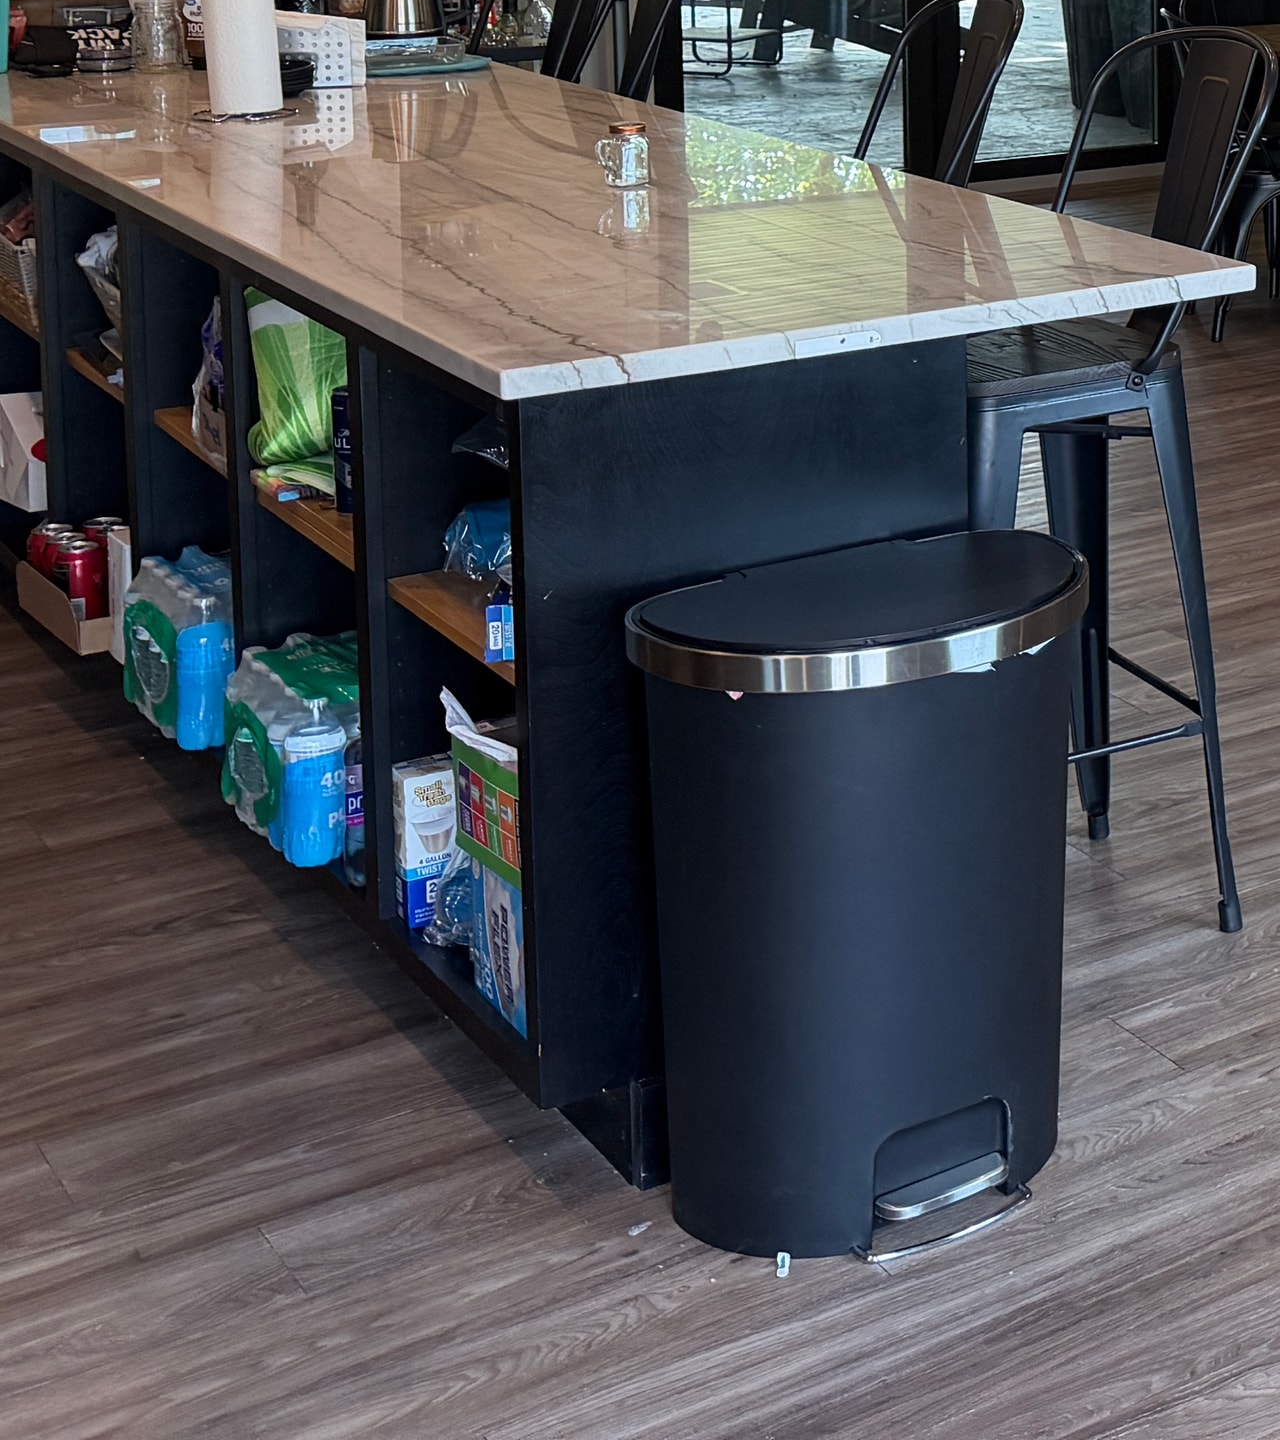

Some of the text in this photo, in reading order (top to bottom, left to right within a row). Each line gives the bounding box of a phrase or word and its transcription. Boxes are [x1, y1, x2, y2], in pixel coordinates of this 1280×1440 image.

[491, 624, 500, 635] 20
[414, 779, 442, 796] Small
[425, 853, 452, 864] GALLON
[416, 863, 442, 876] TWIST
